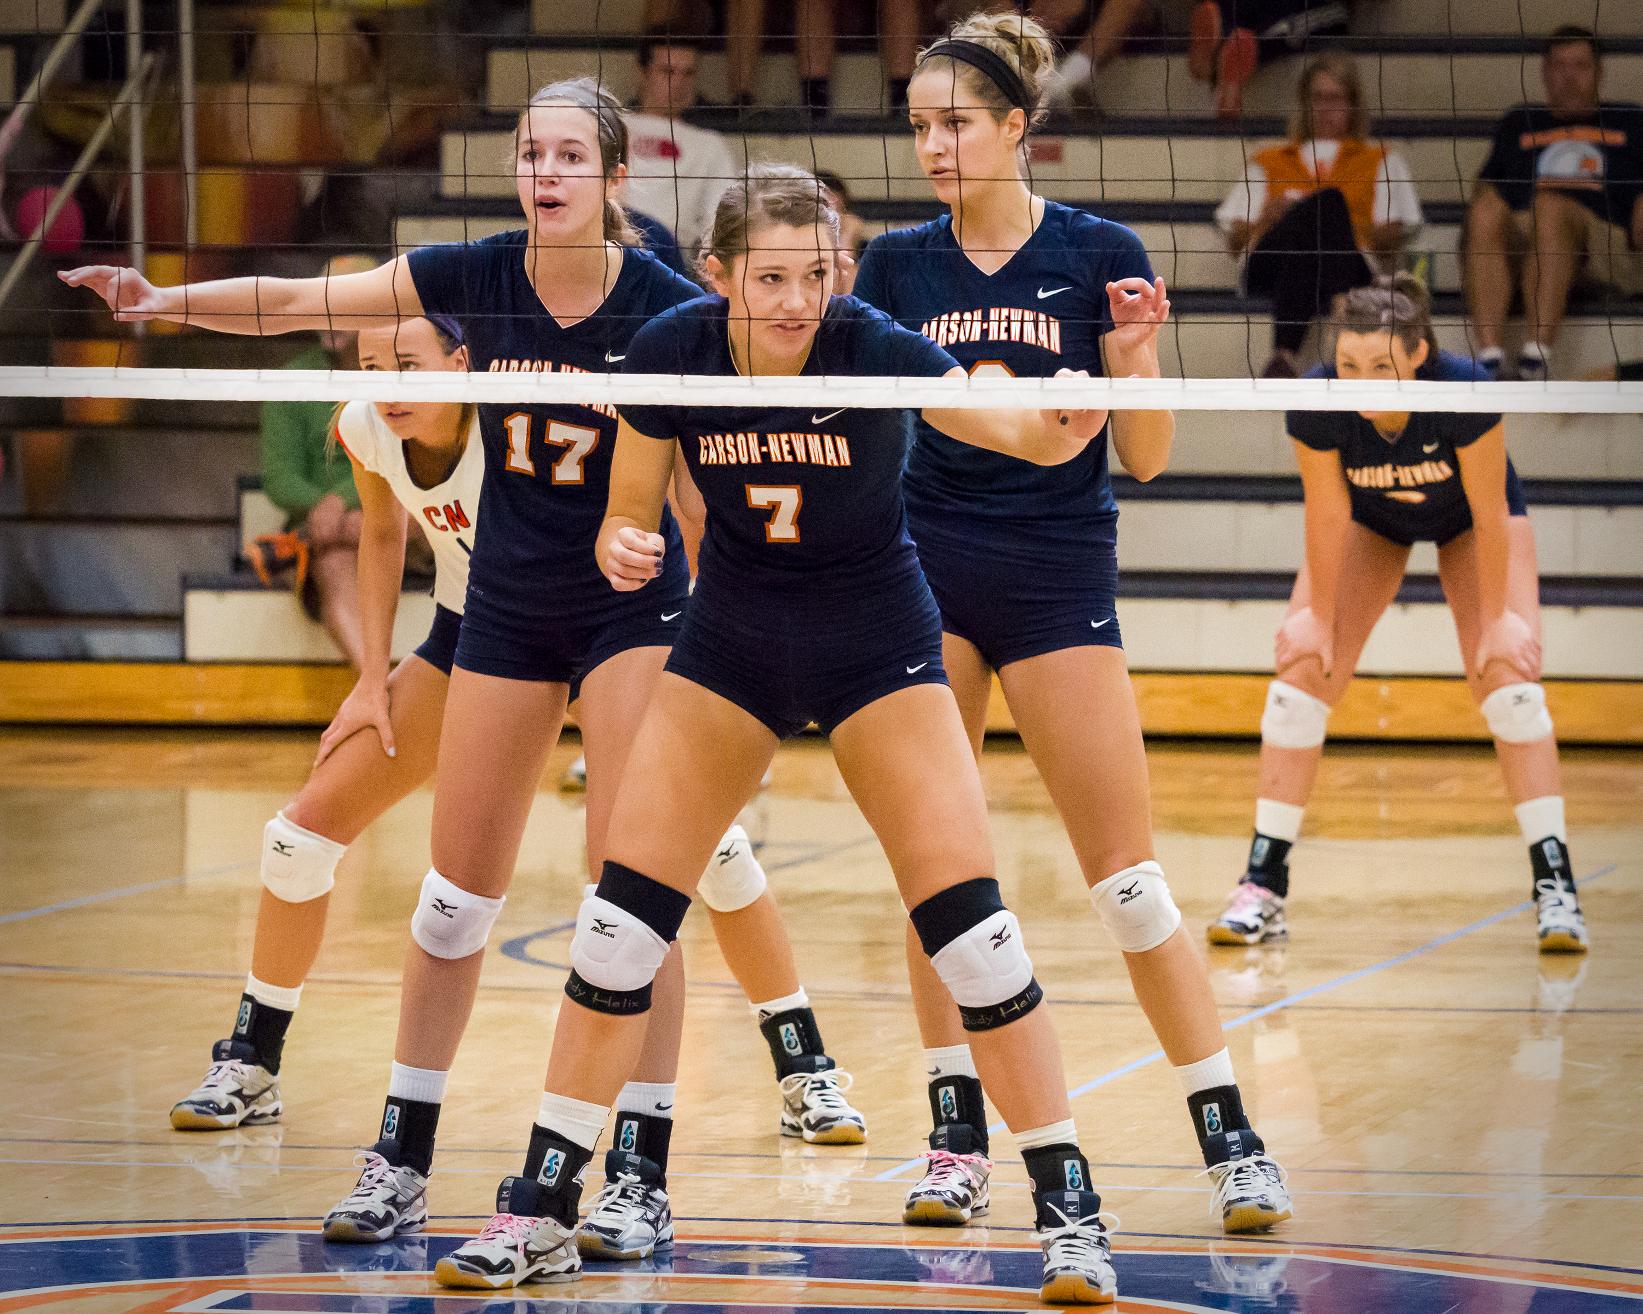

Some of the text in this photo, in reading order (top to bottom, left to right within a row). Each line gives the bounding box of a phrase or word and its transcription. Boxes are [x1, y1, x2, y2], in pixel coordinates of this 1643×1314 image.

[503, 411, 601, 485] 17
[698, 432, 851, 466] CARSON-NEWMAN
[422, 499, 471, 532] CN
[745, 484, 803, 543] 7
